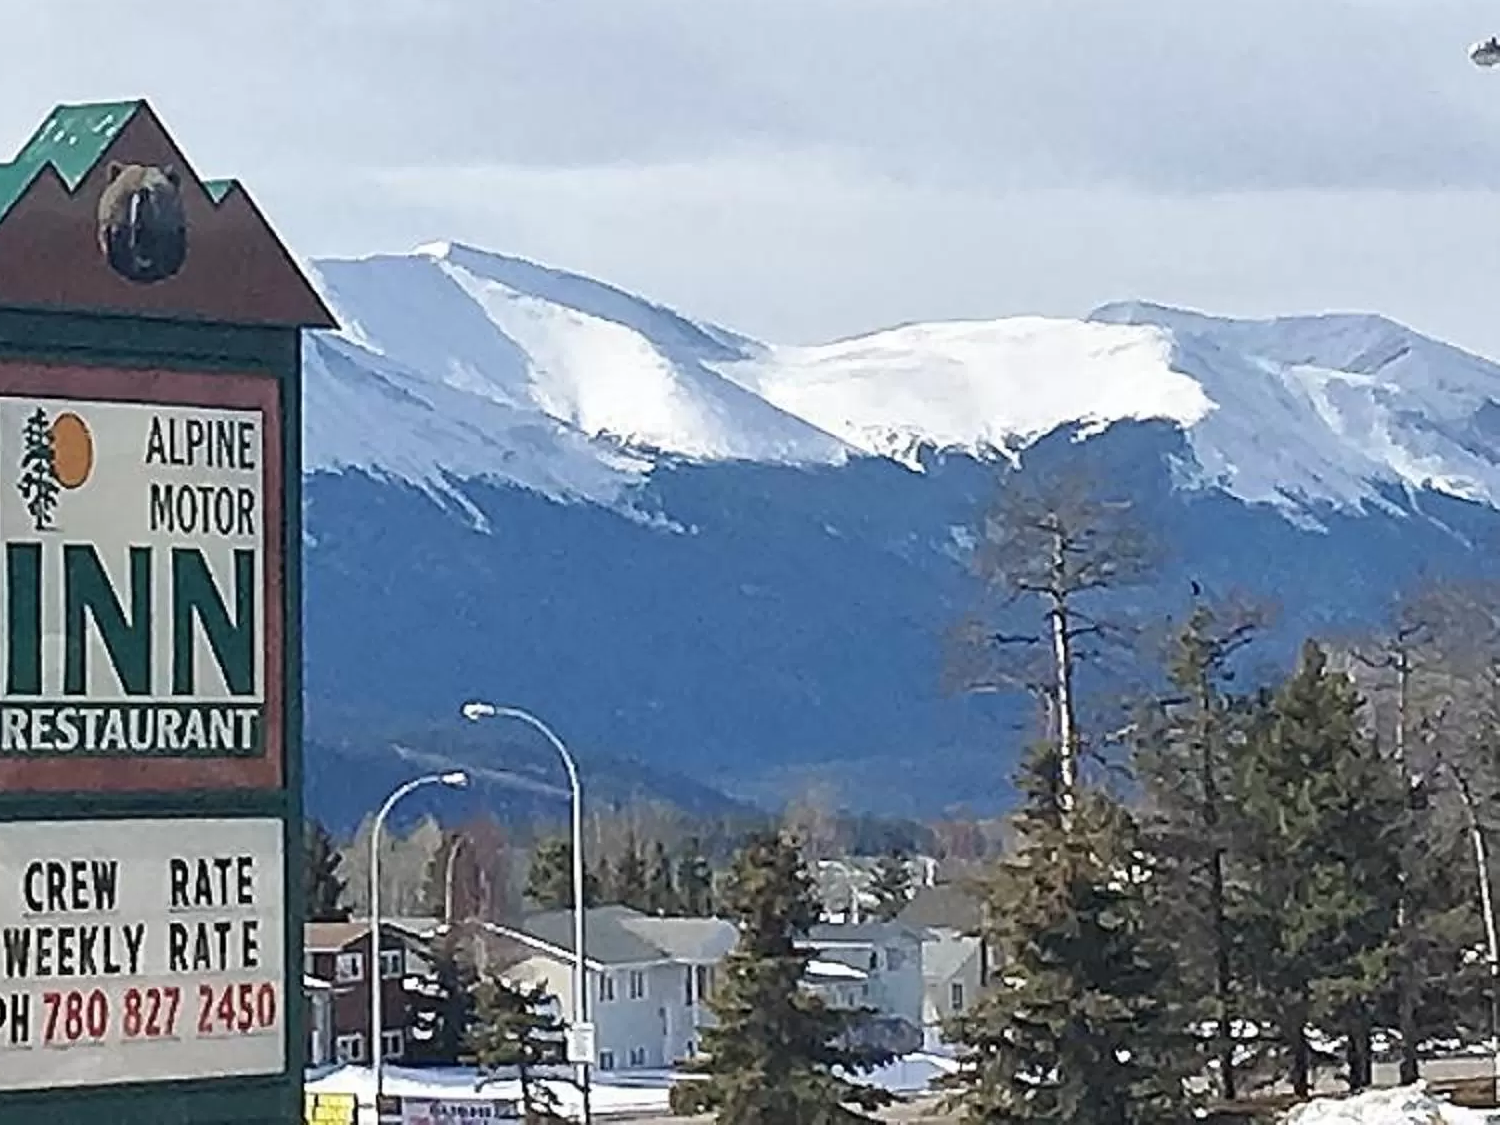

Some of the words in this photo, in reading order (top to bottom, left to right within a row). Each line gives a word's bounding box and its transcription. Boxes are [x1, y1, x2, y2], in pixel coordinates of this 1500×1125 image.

[146, 416, 255, 471] ALPINE
[150, 484, 255, 536] MOTOR
[6, 542, 255, 696] INN
[1, 708, 259, 751] RESTAURANT
[24, 861, 118, 912] CREW
[170, 857, 254, 908] RATE
[3, 924, 145, 978] WEEKLY
[169, 921, 259, 972] RATE
[43, 989, 109, 1041] 780
[124, 986, 181, 1037] 827
[198, 982, 277, 1033] 2450
